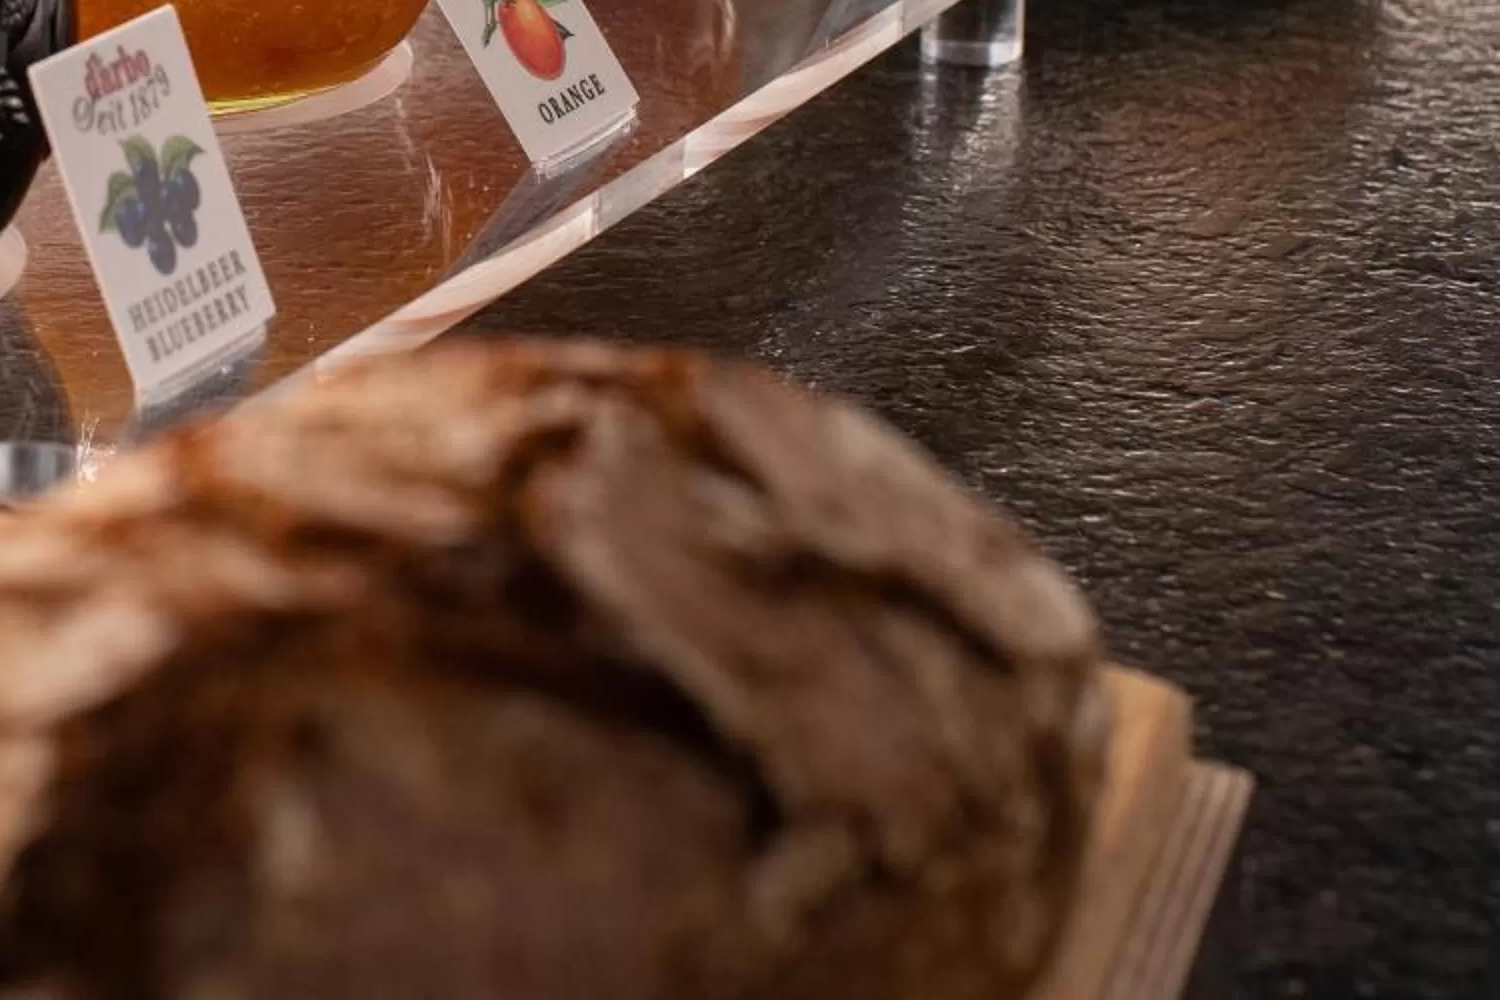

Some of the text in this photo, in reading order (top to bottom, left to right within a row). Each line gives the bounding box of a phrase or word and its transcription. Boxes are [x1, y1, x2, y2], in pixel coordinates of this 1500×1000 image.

[72, 63, 171, 136] Seit 1879
[537, 73, 606, 125] ORANGE
[125, 248, 247, 334] HEIDELBEER
[144, 283, 251, 364] BLUEBERRY
